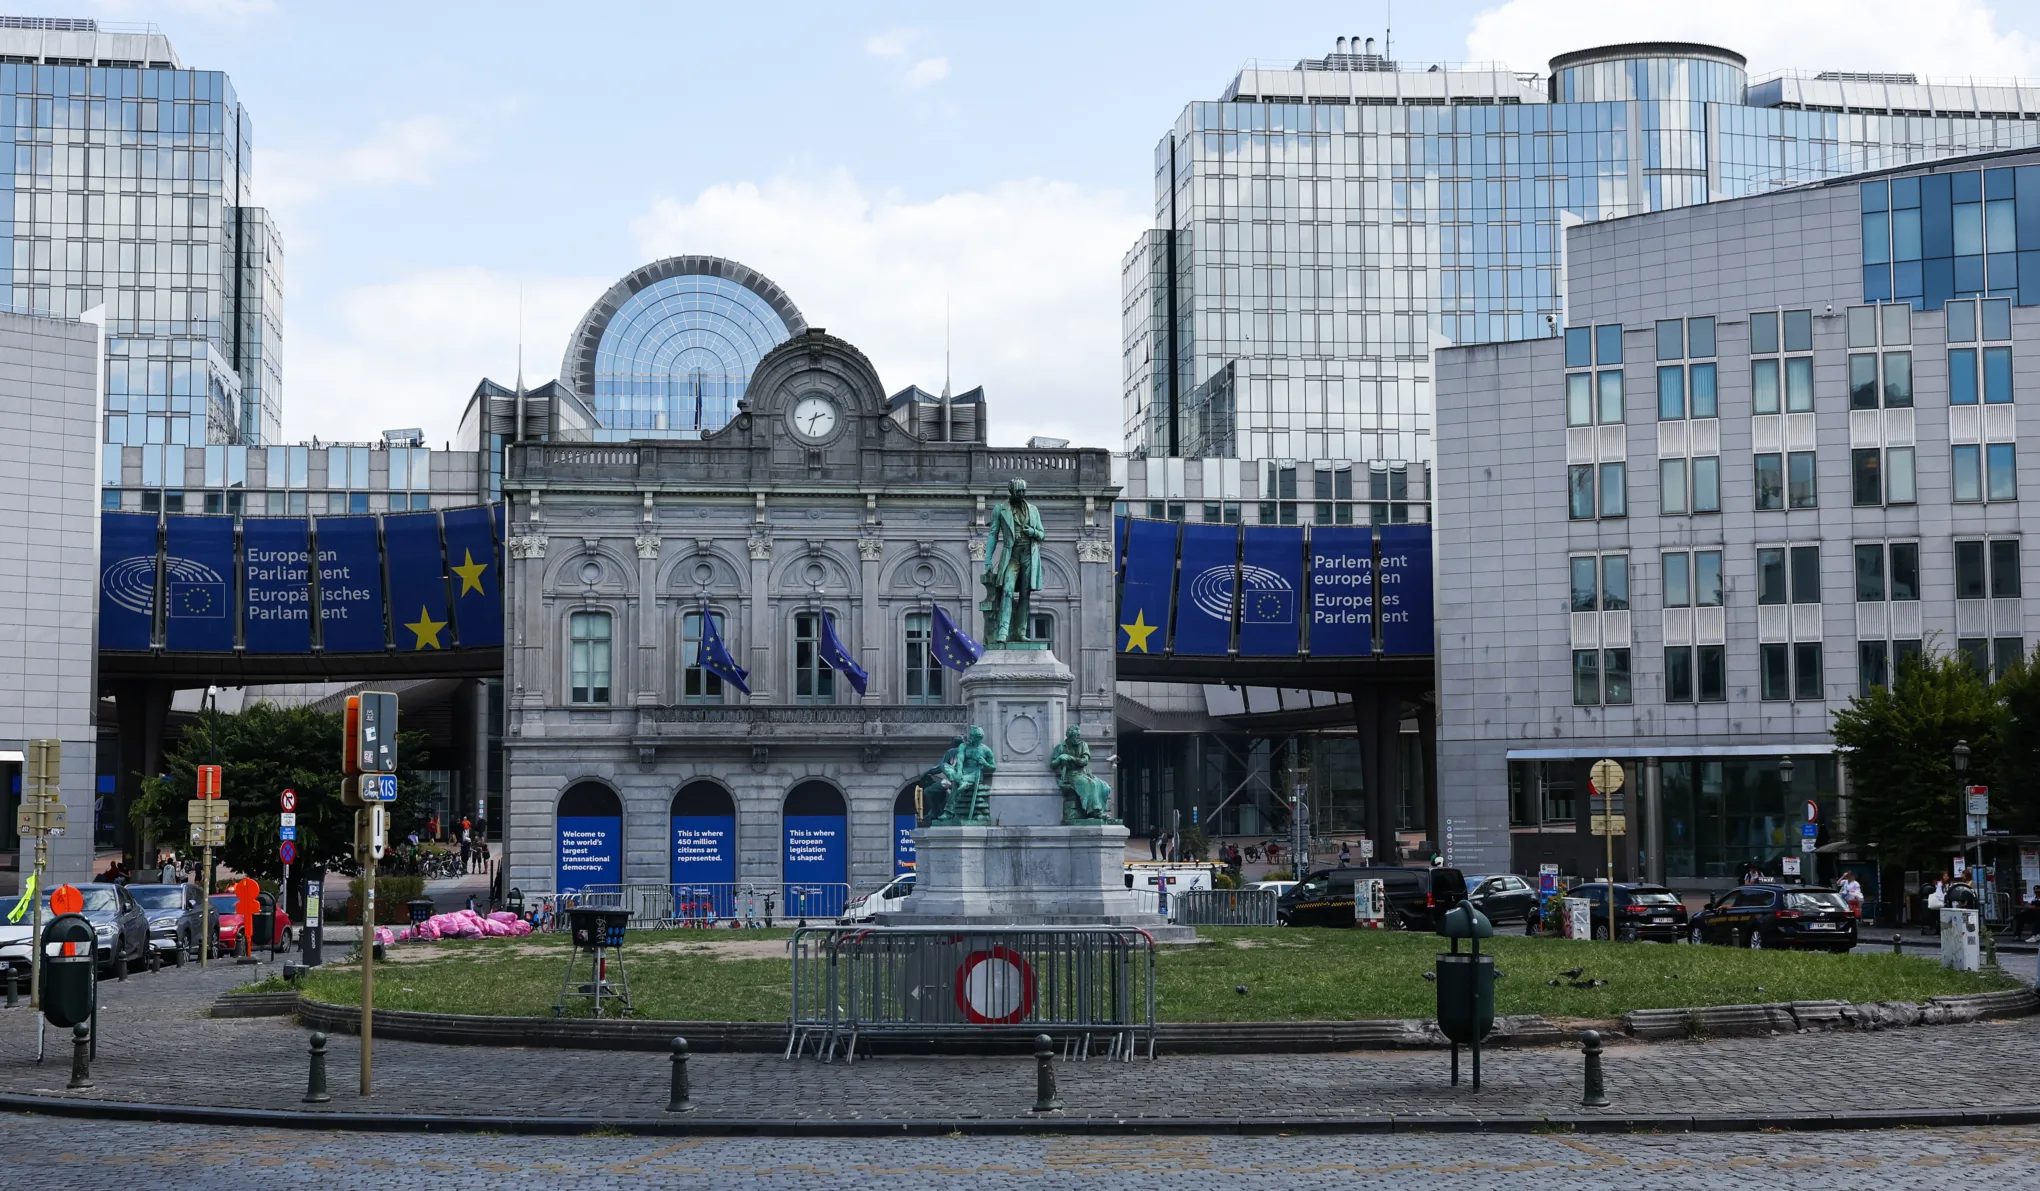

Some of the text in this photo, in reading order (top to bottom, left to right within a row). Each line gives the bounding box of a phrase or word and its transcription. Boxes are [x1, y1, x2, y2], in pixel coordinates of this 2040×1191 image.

[248, 548, 337, 564] European
[1314, 554, 1408, 568] Parlement
[248, 566, 350, 580] Parliament
[1314, 571, 1400, 587] européen
[248, 586, 370, 604] Europäisches
[1315, 593, 1400, 609] Europees
[249, 605, 348, 620] Parlament
[1314, 610, 1408, 624] Parlement
